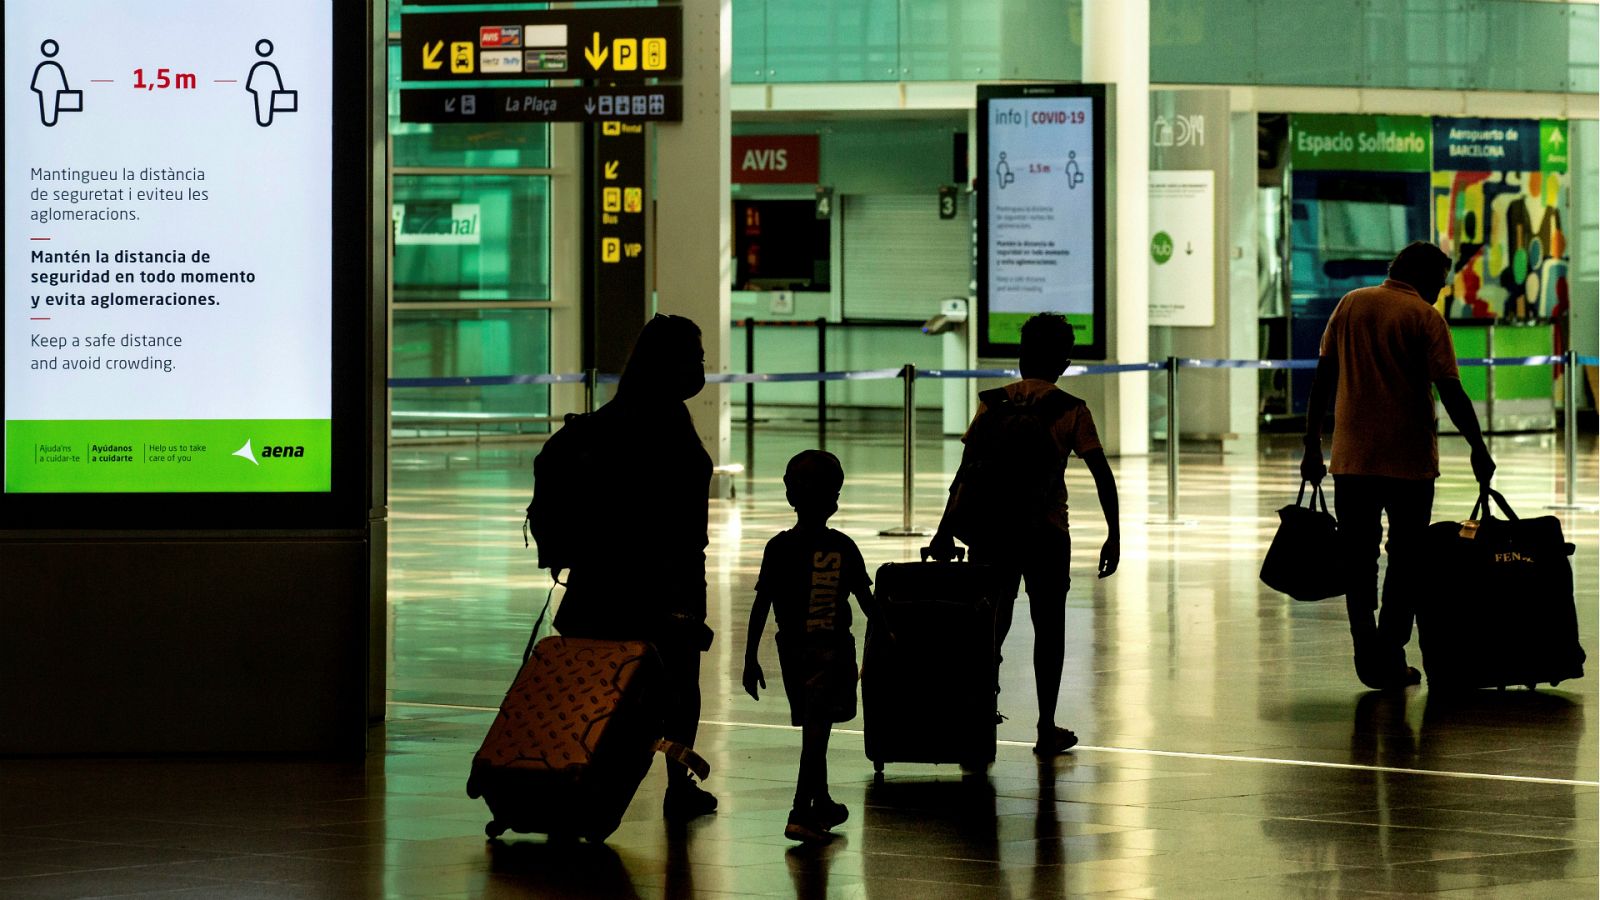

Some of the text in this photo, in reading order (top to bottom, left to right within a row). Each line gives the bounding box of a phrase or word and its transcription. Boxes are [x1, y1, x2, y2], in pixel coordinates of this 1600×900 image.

[505, 95, 558, 117] La Plaça
[994, 107, 1022, 124] info
[1449, 128, 1519, 142] Aeropuerto de
[1297, 131, 1425, 157] Espacio Solidario
[1449, 144, 1505, 157] BARCELONA
[742, 149, 787, 171] AVIS
[30, 167, 205, 184] Mantingueu la distància
[30, 187, 49, 201] de
[53, 188, 124, 204] seguretat
[136, 187, 183, 201] eviteu
[188, 187, 209, 201] les
[818, 197, 830, 215] 4
[942, 197, 953, 214] 3
[30, 207, 140, 224] aglomeracions.
[31, 249, 211, 264] Mantén la distancia de
[623, 243, 642, 257] VIP
[30, 269, 256, 286] seguridad en todo momento
[30, 292, 220, 309] y evita aglomeraciones.
[30, 333, 183, 348] Keep a safe distance
[30, 356, 176, 373] and avoid crowding.
[91, 444, 133, 454] Ayúdanos
[149, 444, 167, 453] Help
[179, 444, 187, 452] to
[189, 444, 207, 452] take
[261, 446, 305, 458] aena
[46, 454, 81, 463] cuidar-te
[98, 454, 134, 463] cuidarte
[167, 454, 176, 462] of
[177, 456, 192, 464] you
